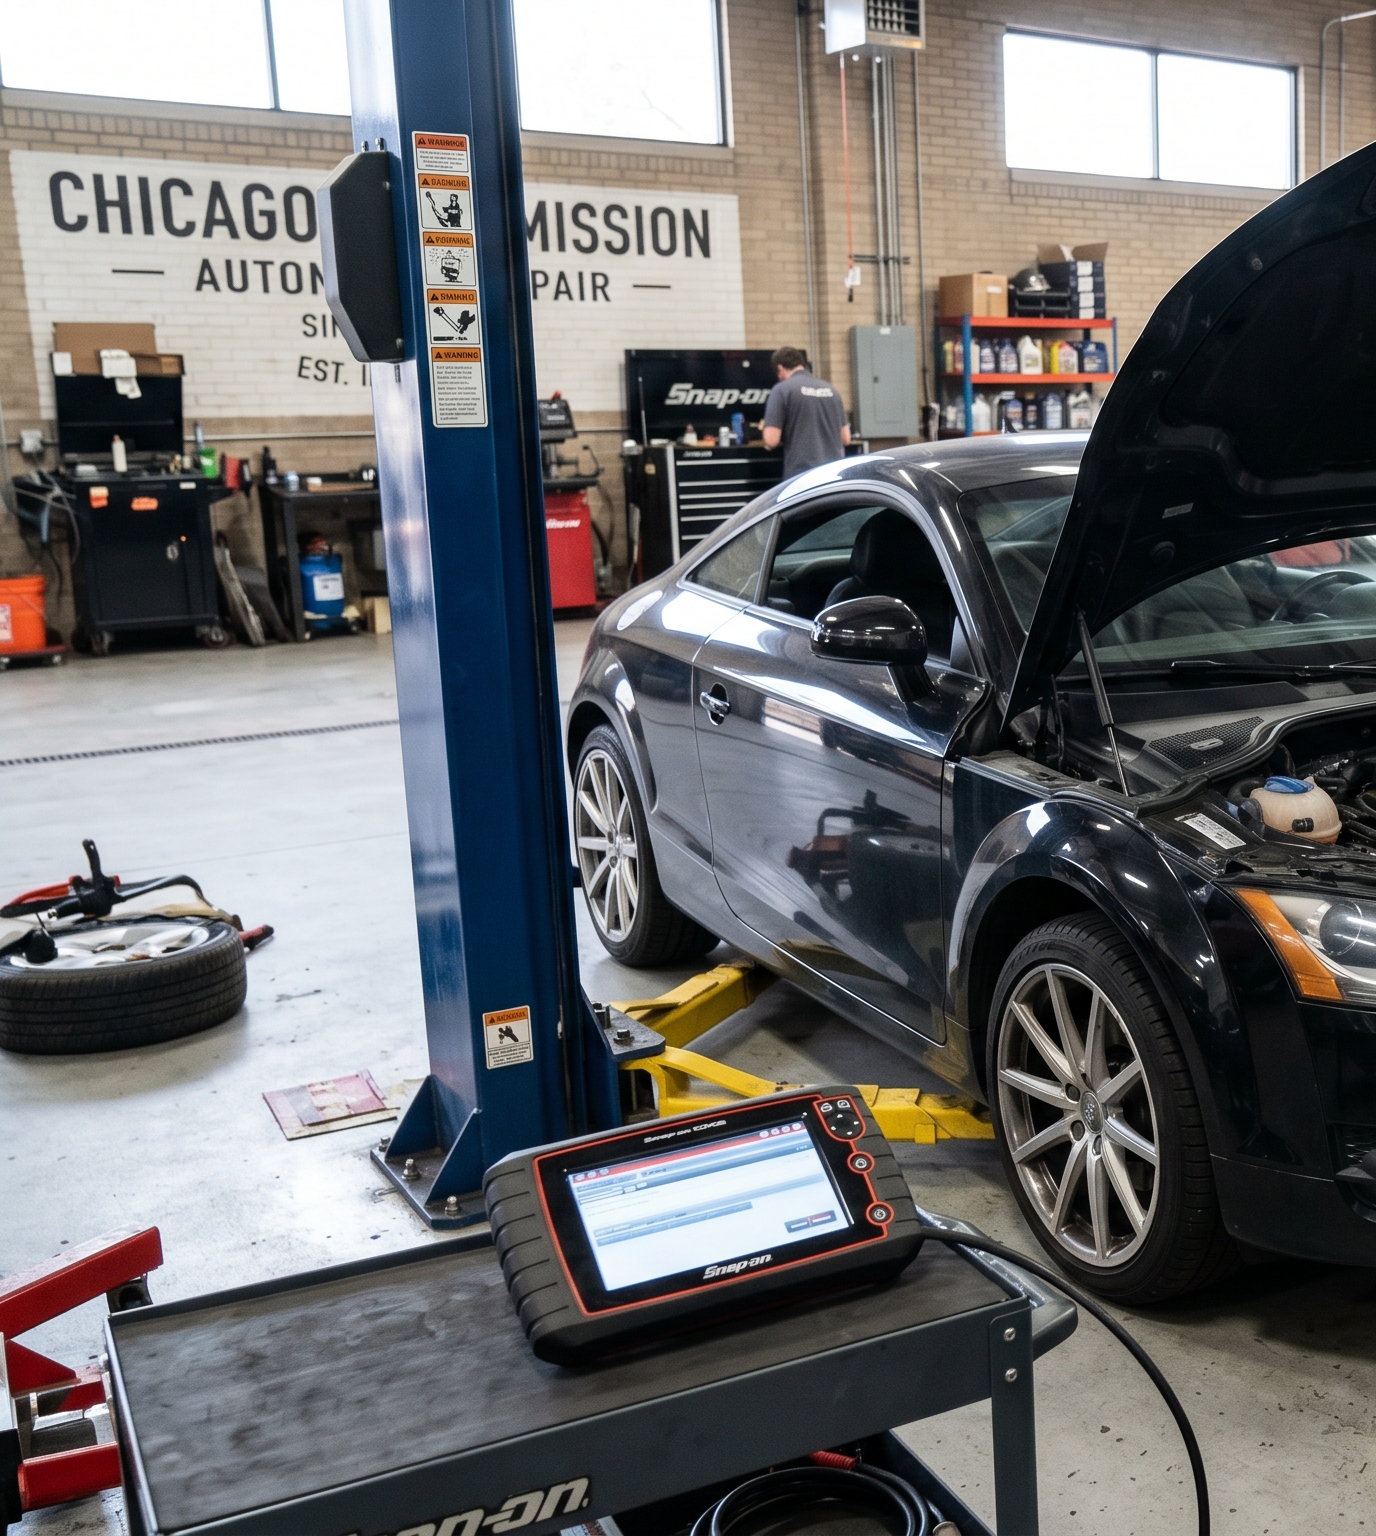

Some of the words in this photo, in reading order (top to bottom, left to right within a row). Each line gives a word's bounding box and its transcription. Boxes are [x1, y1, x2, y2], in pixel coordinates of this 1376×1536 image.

[49, 171, 317, 243] CHICAGO
[526, 200, 711, 259] MISSION
[531, 270, 611, 302] PAIR
[297, 356, 348, 386] EST.
